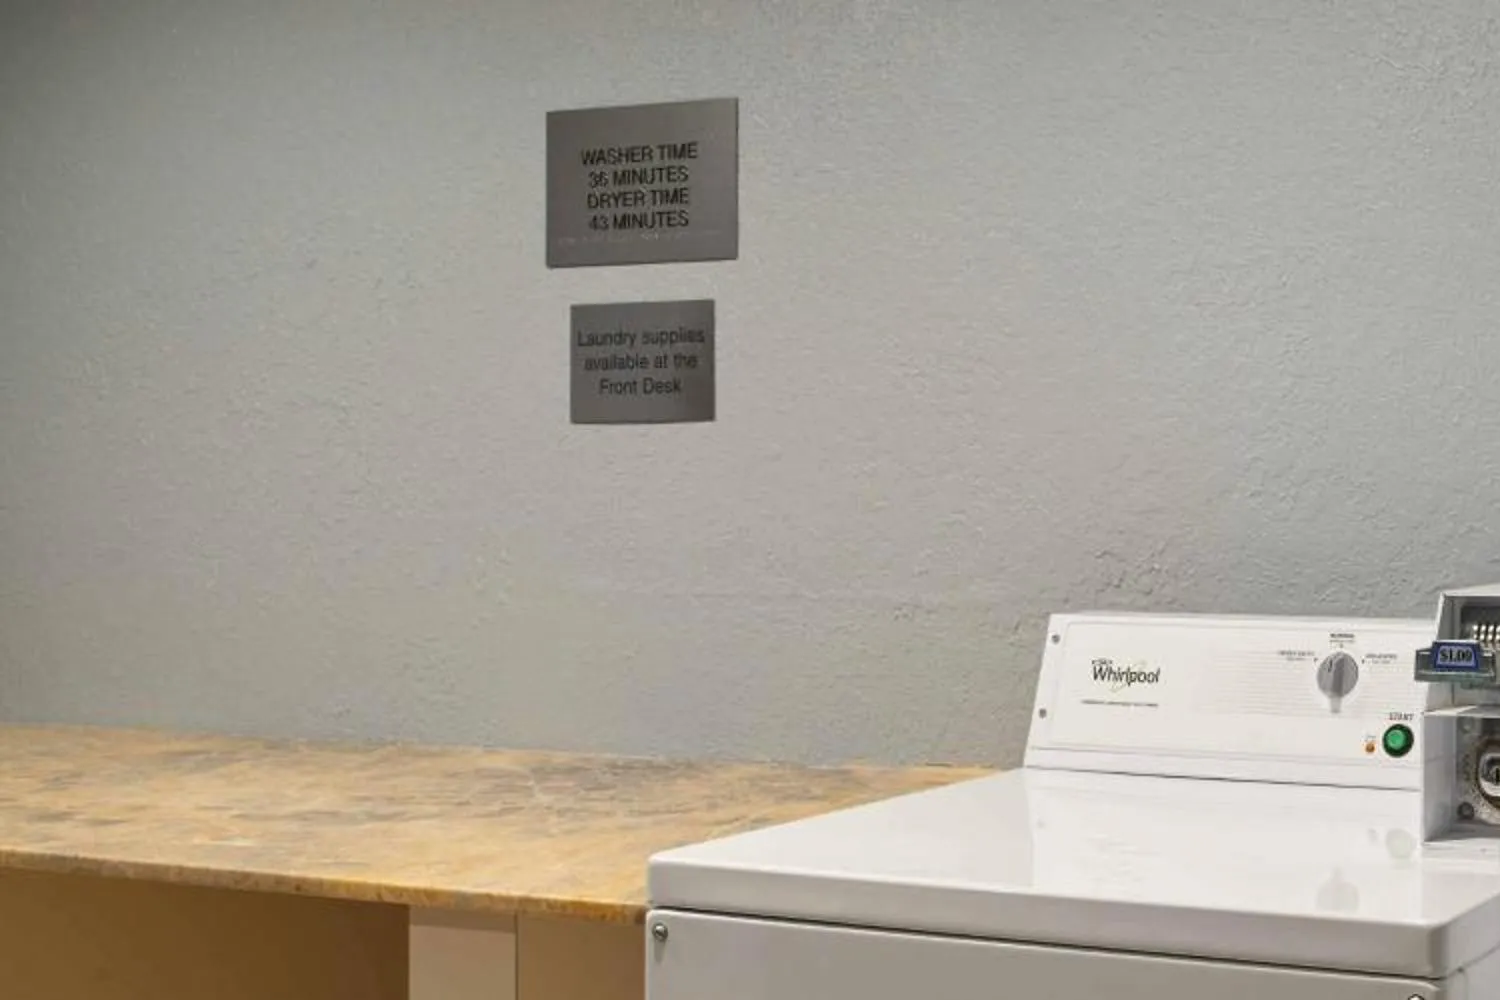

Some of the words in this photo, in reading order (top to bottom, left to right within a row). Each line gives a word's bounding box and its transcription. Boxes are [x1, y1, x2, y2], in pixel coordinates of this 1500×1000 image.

[580, 145, 654, 165] WASHER
[657, 141, 698, 160] TIME
[613, 165, 689, 186] MINUTES
[587, 190, 645, 209] DRYER
[651, 187, 689, 206] TIME
[589, 214, 609, 231] 43
[613, 210, 689, 230] MINUTES
[577, 329, 636, 348] Laundry
[641, 326, 705, 347] supplies
[584, 353, 651, 371] available
[653, 355, 668, 369] at
[673, 352, 698, 369] the
[599, 378, 638, 396] Front
[642, 377, 682, 395] Desk
[1093, 665, 1161, 687] Whirlpool
